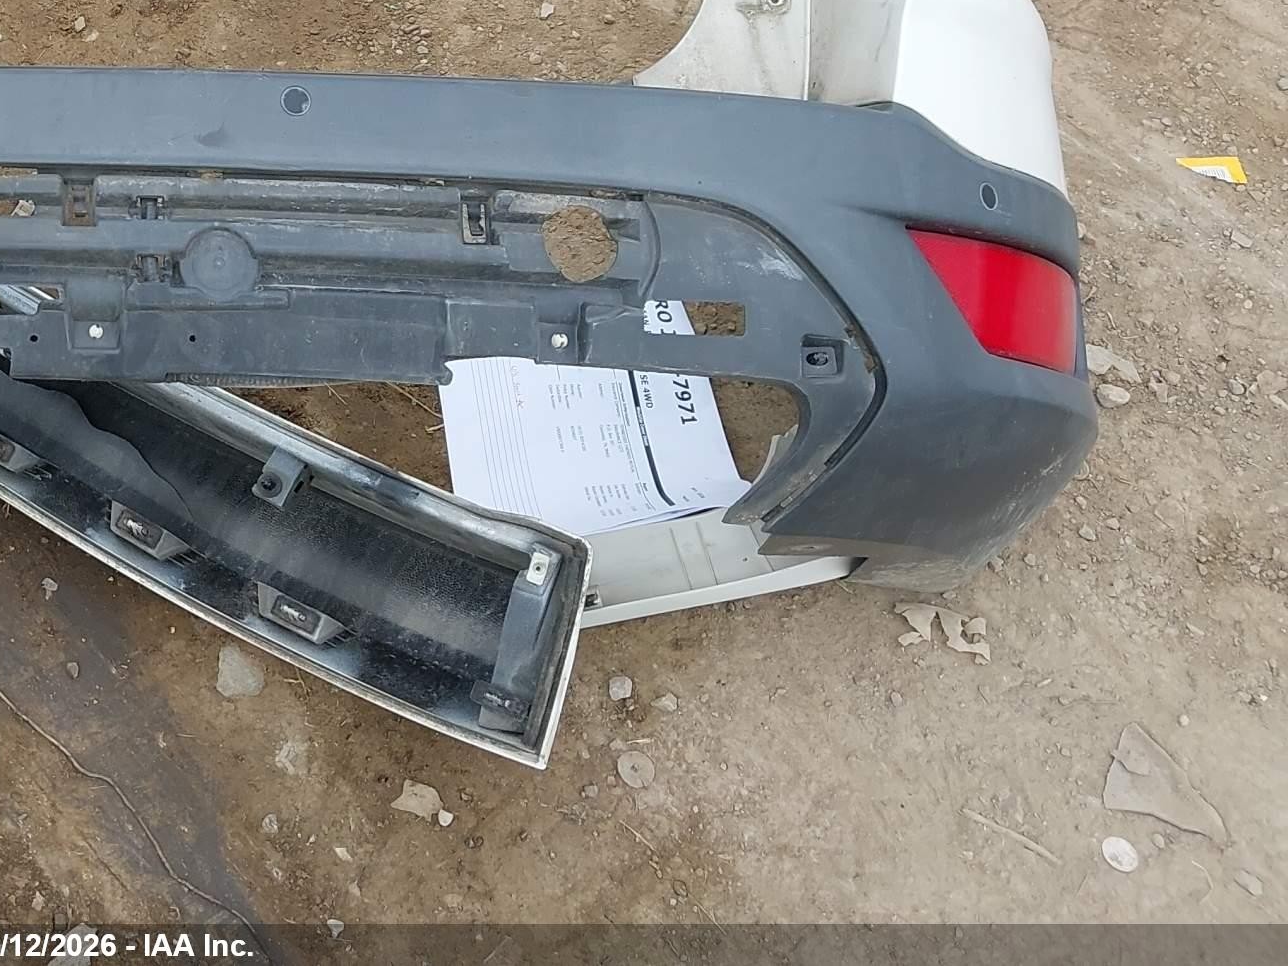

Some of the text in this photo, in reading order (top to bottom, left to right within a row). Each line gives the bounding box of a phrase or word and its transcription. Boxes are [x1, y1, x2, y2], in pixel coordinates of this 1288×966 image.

[655, 300, 673, 323] RO
[639, 374, 649, 386] SE
[642, 387, 654, 409] 4WD
